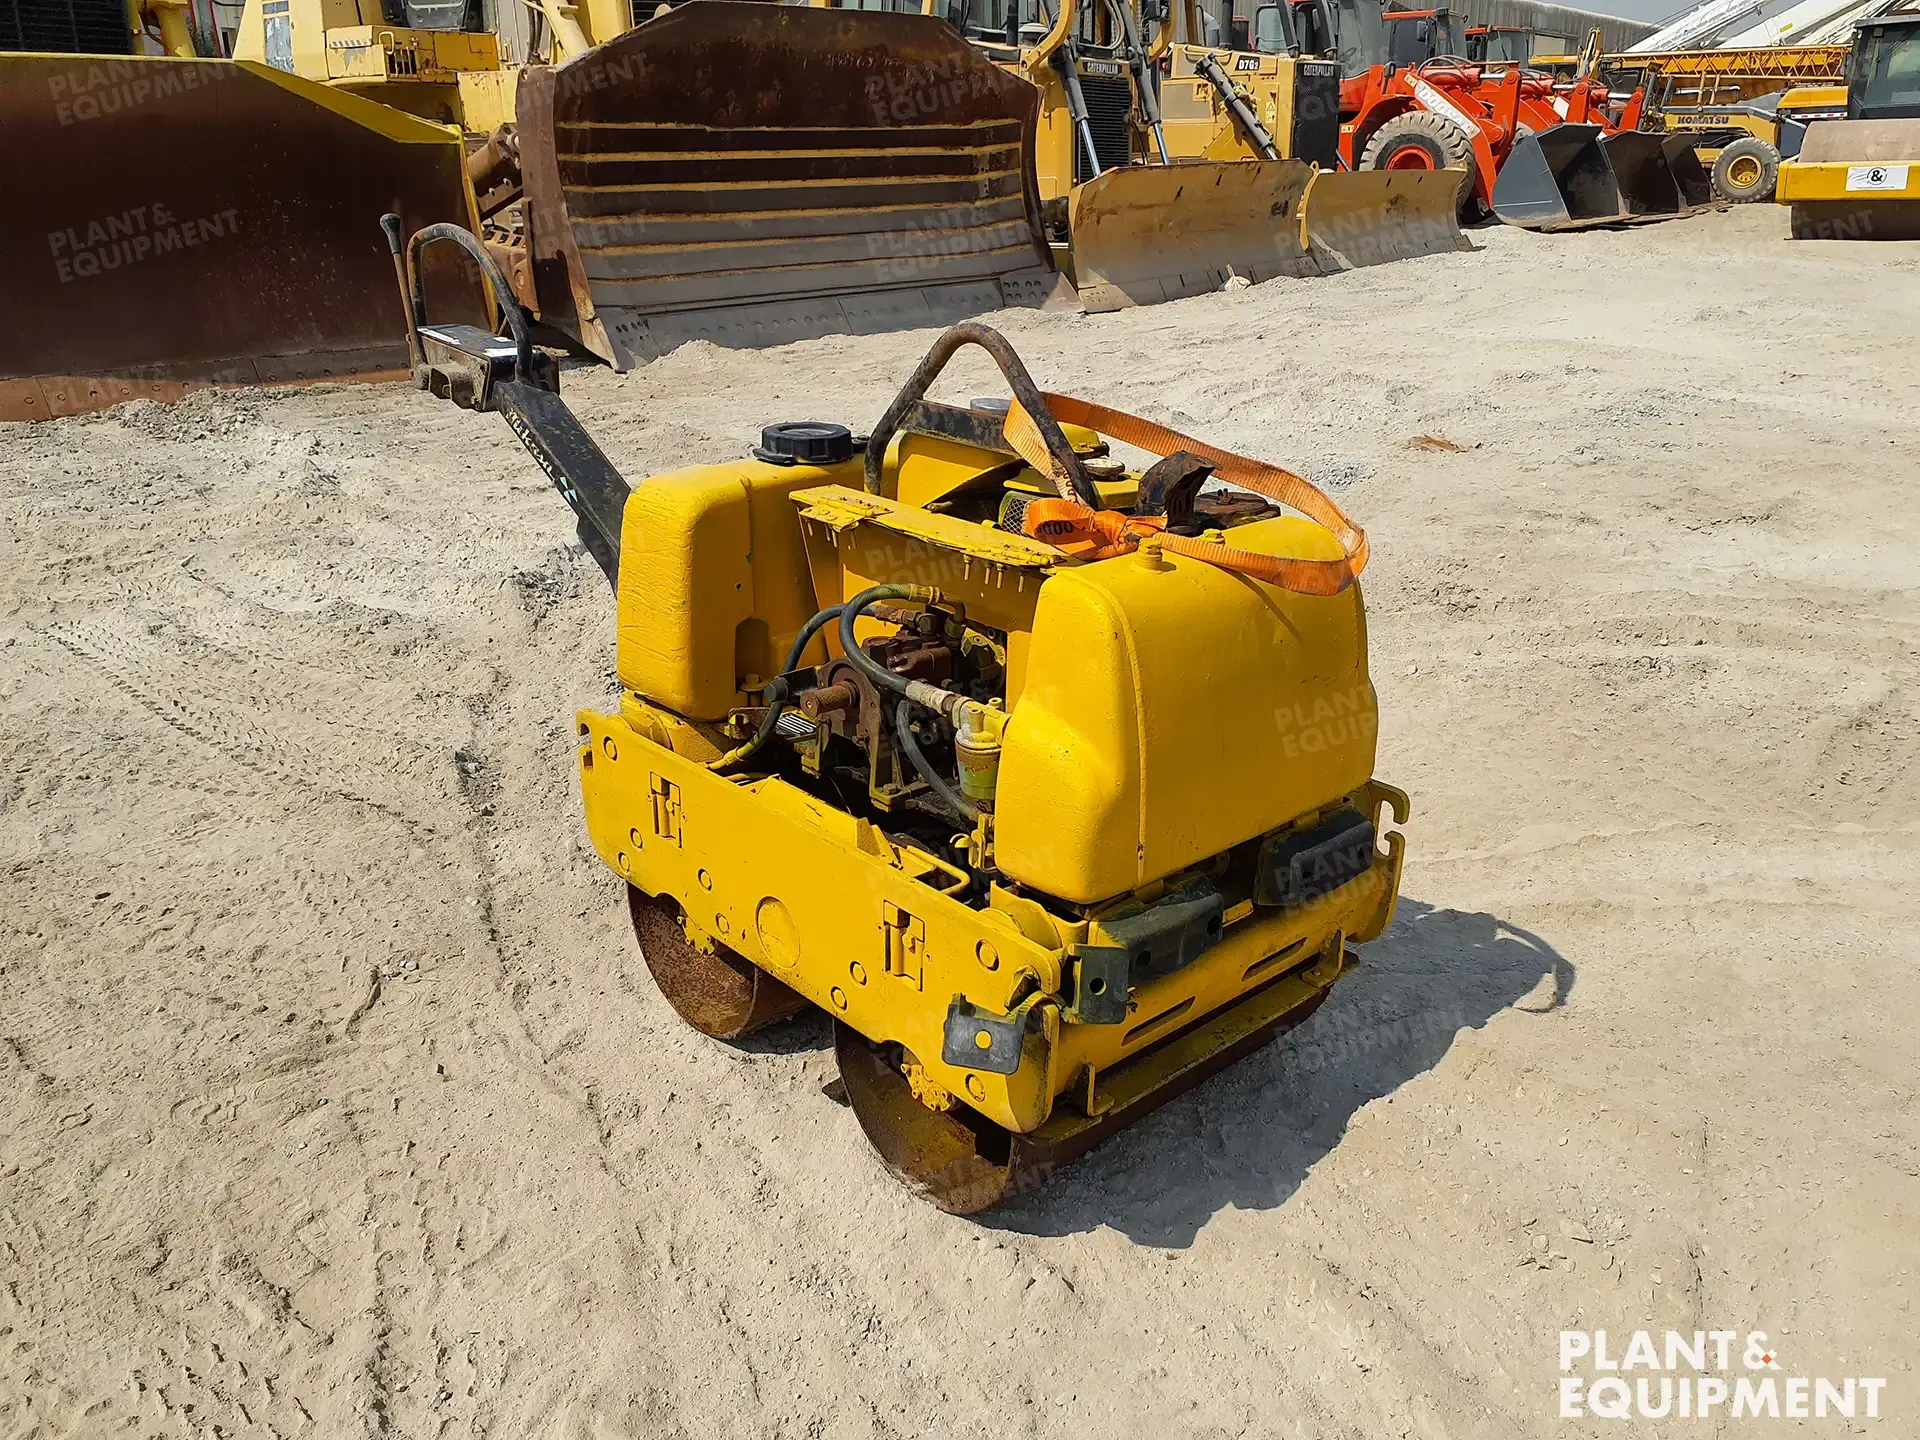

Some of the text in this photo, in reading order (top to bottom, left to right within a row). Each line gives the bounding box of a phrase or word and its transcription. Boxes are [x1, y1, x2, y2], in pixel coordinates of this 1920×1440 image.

[1087, 62, 1118, 74] CATERPILLAR
[1303, 64, 1334, 76] CATERPILLAR
[1677, 116, 1729, 124] KOMATSU
